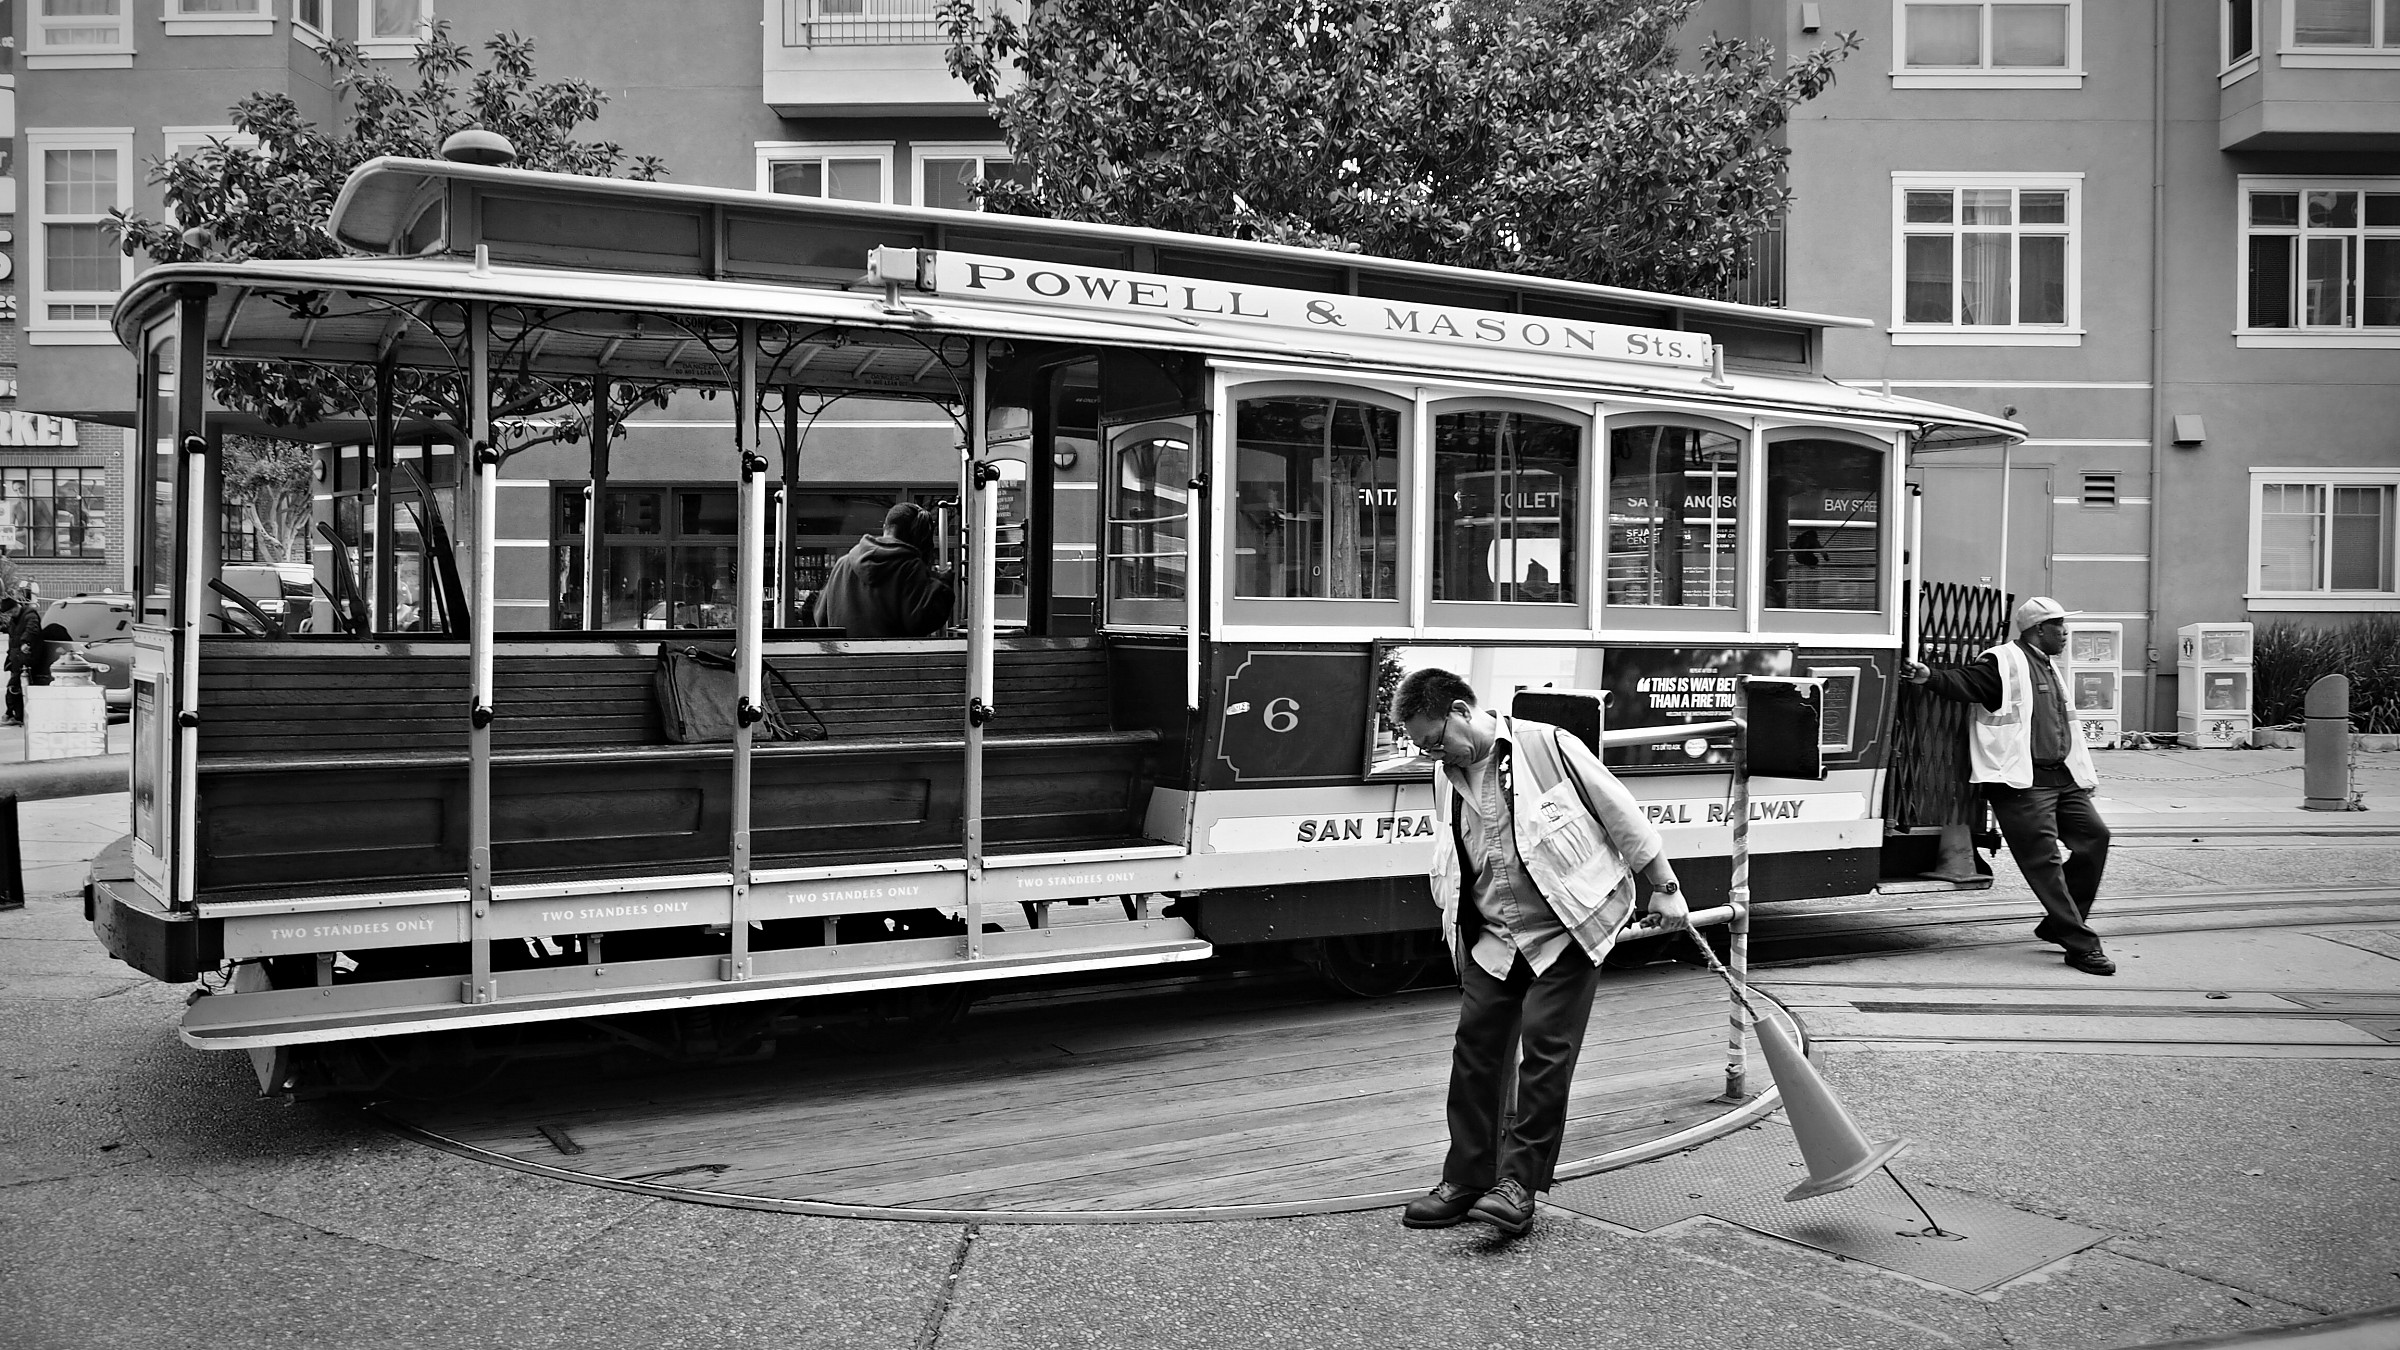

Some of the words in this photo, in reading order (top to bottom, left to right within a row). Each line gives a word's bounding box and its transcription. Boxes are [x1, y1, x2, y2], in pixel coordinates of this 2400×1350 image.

[965, 262, 1269, 318] POWELL
[1306, 300, 1347, 327] &
[1384, 307, 1596, 351] MASON
[1627, 333, 1693, 359] Sts.
[1359, 488, 1397, 506] FMT
[1500, 492, 1559, 509] OILET
[1824, 499, 1849, 512] BAY
[1677, 678, 1689, 692] IS
[1690, 677, 1715, 692] WAY
[1650, 694, 1681, 708] THAN
[1681, 694, 1690, 708] A
[1691, 694, 1714, 708] FIRE
[1263, 697, 1300, 732] 6
[1298, 818, 1363, 842] SAN
[1376, 815, 1434, 839] FRA
[1707, 800, 1805, 823] RALWAY
[1017, 877, 1046, 888] TWO
[1049, 874, 1103, 886] STANDEES
[1106, 871, 1136, 883] ONLY
[788, 893, 817, 904] TWO
[822, 889, 883, 902] STANDEES
[888, 885, 920, 898] ONLY
[541, 911, 576, 922] TWO
[579, 905, 649, 919] STANDEES
[653, 901, 689, 914] ONLY
[270, 928, 307, 940] TWO
[313, 923, 389, 938] STANDEES
[396, 919, 435, 933] ONLY
